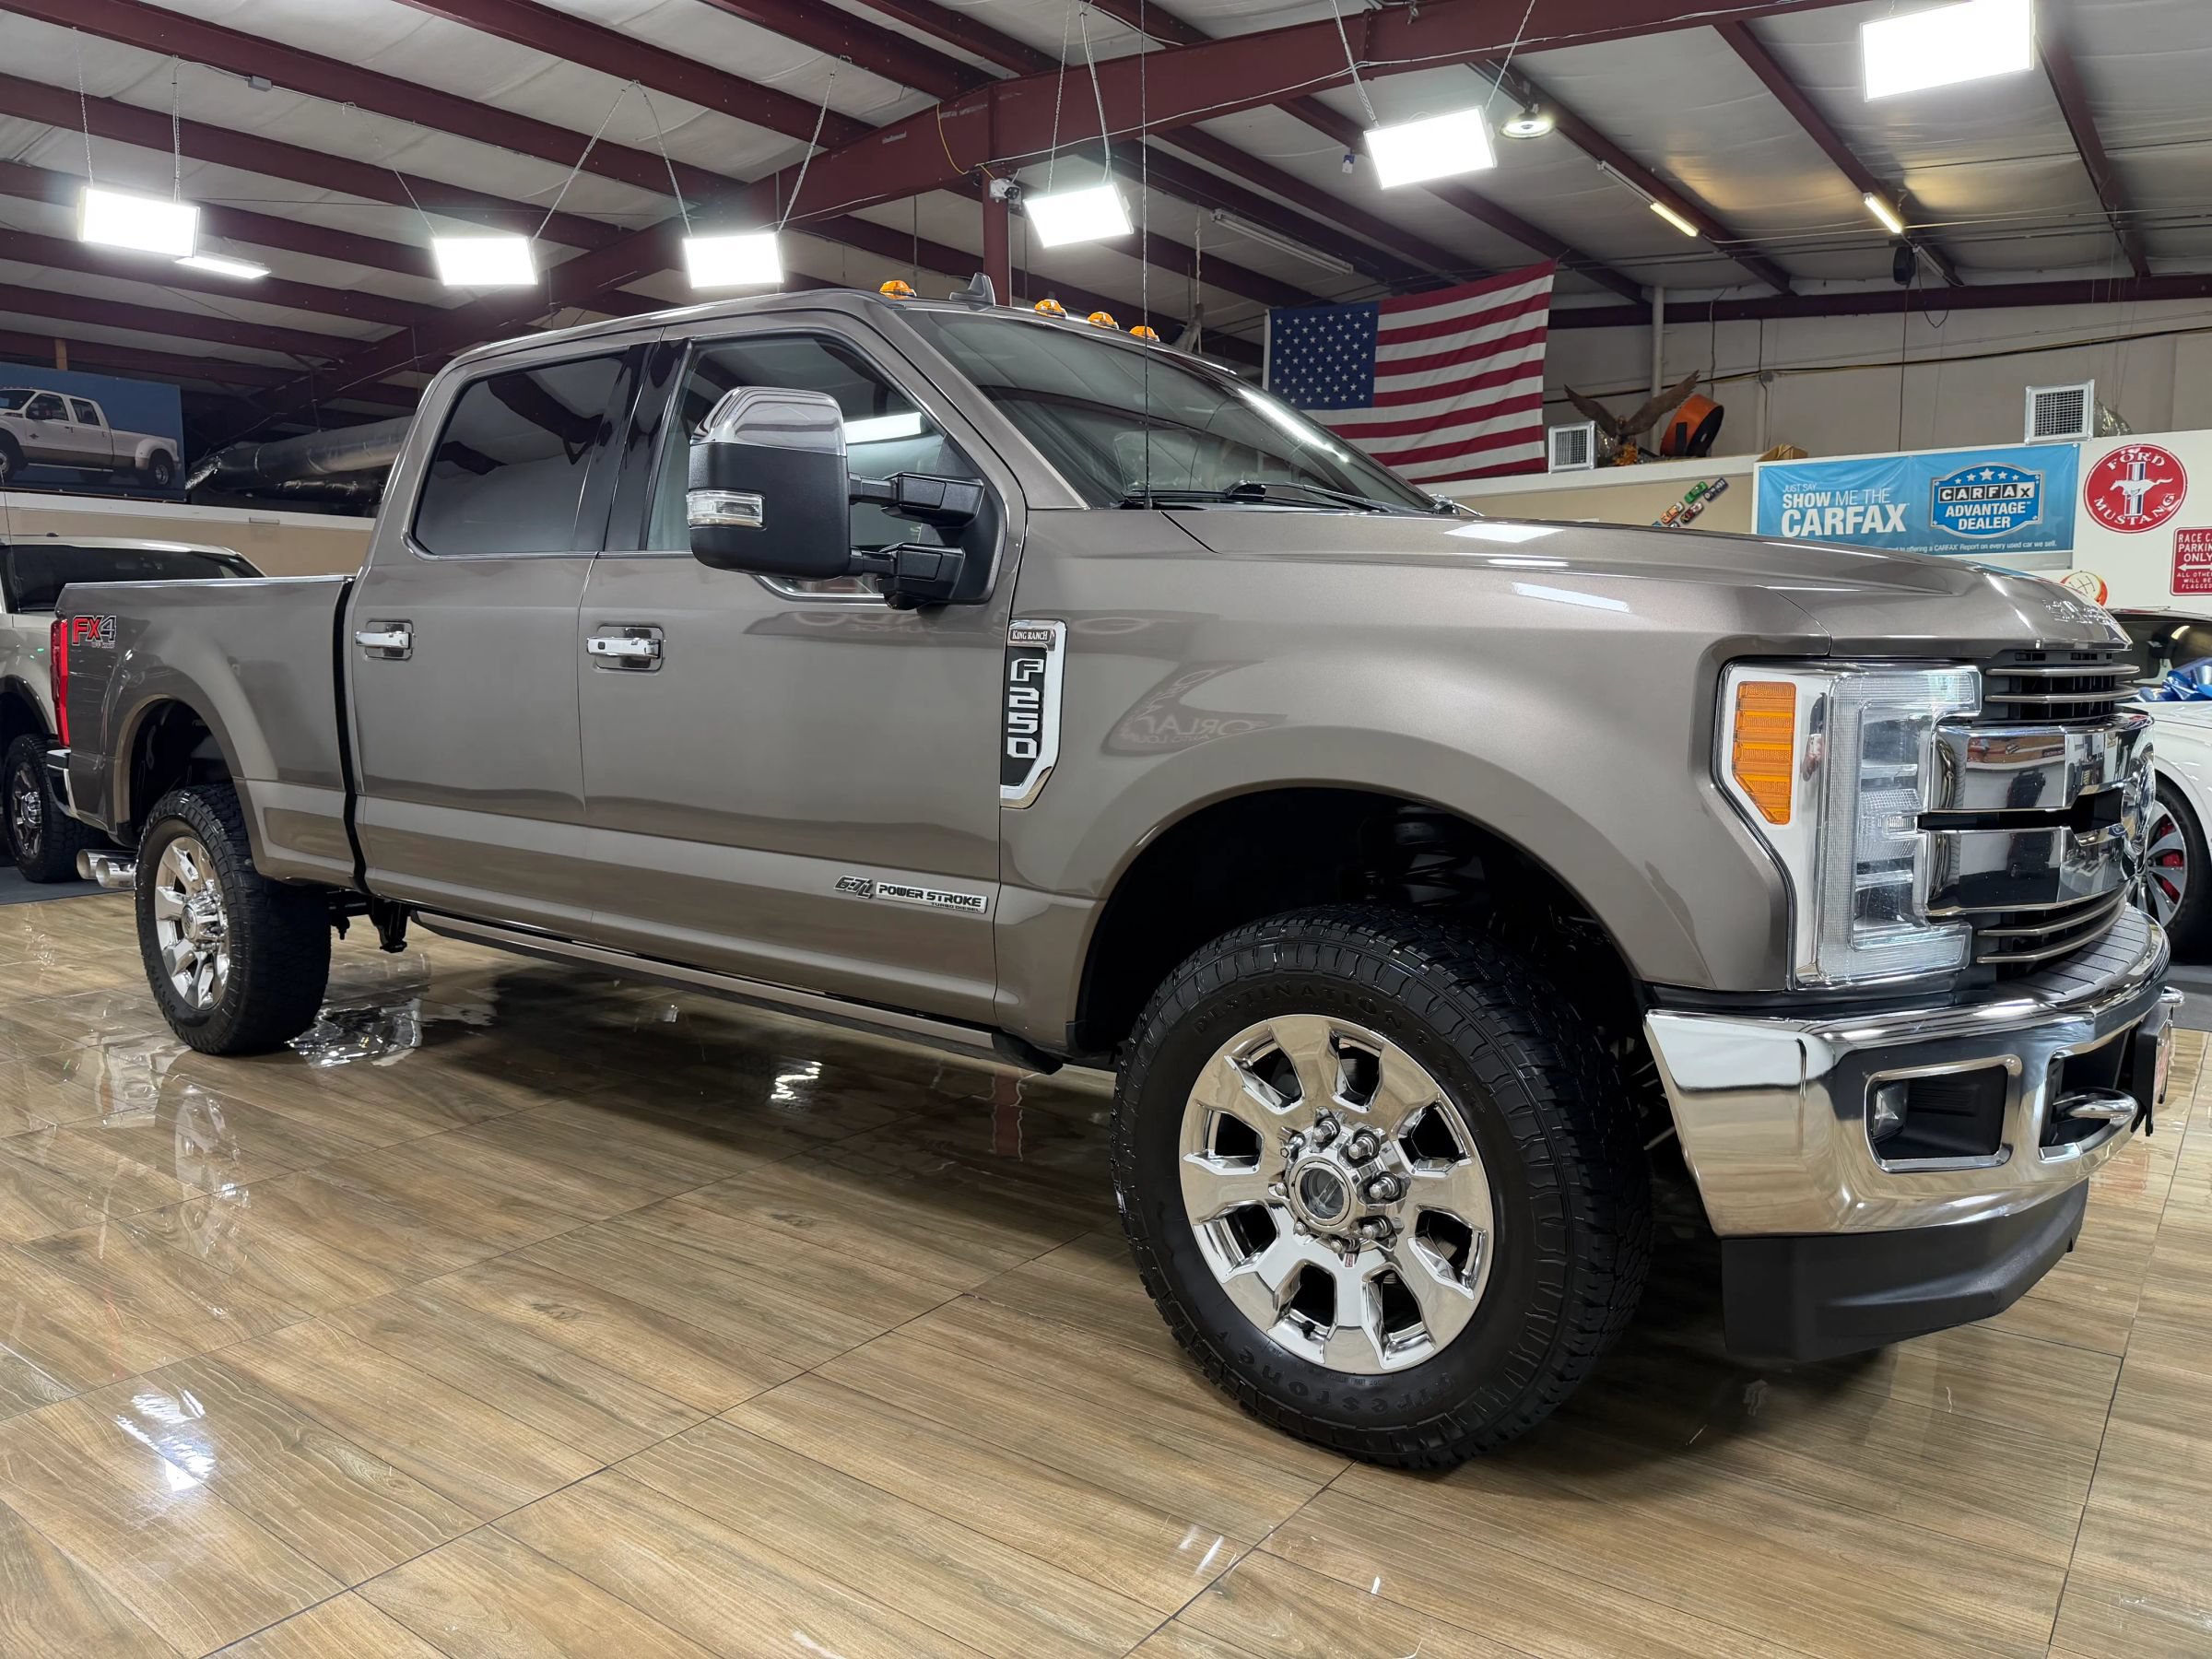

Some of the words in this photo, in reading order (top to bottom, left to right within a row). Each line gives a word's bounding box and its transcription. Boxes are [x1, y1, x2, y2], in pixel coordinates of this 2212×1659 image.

[2107, 452, 2166, 470] FORD
[1783, 484, 1800, 493] JUST
[1803, 482, 1818, 491] SAY
[1941, 485, 2031, 500] CARFAX
[1783, 491, 1831, 509] SHOW
[1835, 489, 1858, 506] ME
[1863, 488, 1891, 504] THE
[1945, 501, 2027, 517] ADVANTAGE
[2094, 493, 2176, 526] MUSTANG
[1782, 502, 1907, 537] CARFAX
[1958, 516, 2011, 531] DEALER
[2178, 533, 2202, 543] RACE
[2205, 533, 2212, 543] C
[1959, 543, 1980, 551] Report
[1989, 542, 2007, 550] every
[2183, 553, 2212, 562] ONLY
[72, 615, 116, 646] FX4
[1012, 629, 1027, 640] KING
[1028, 630, 1048, 641] RANCH
[1006, 657, 1045, 759] F250
[834, 875, 874, 899] 6.7L
[878, 884, 924, 900] POWER
[926, 891, 982, 908] STROKE
[931, 901, 954, 910] TURBO
[955, 905, 982, 913] DIESEL
